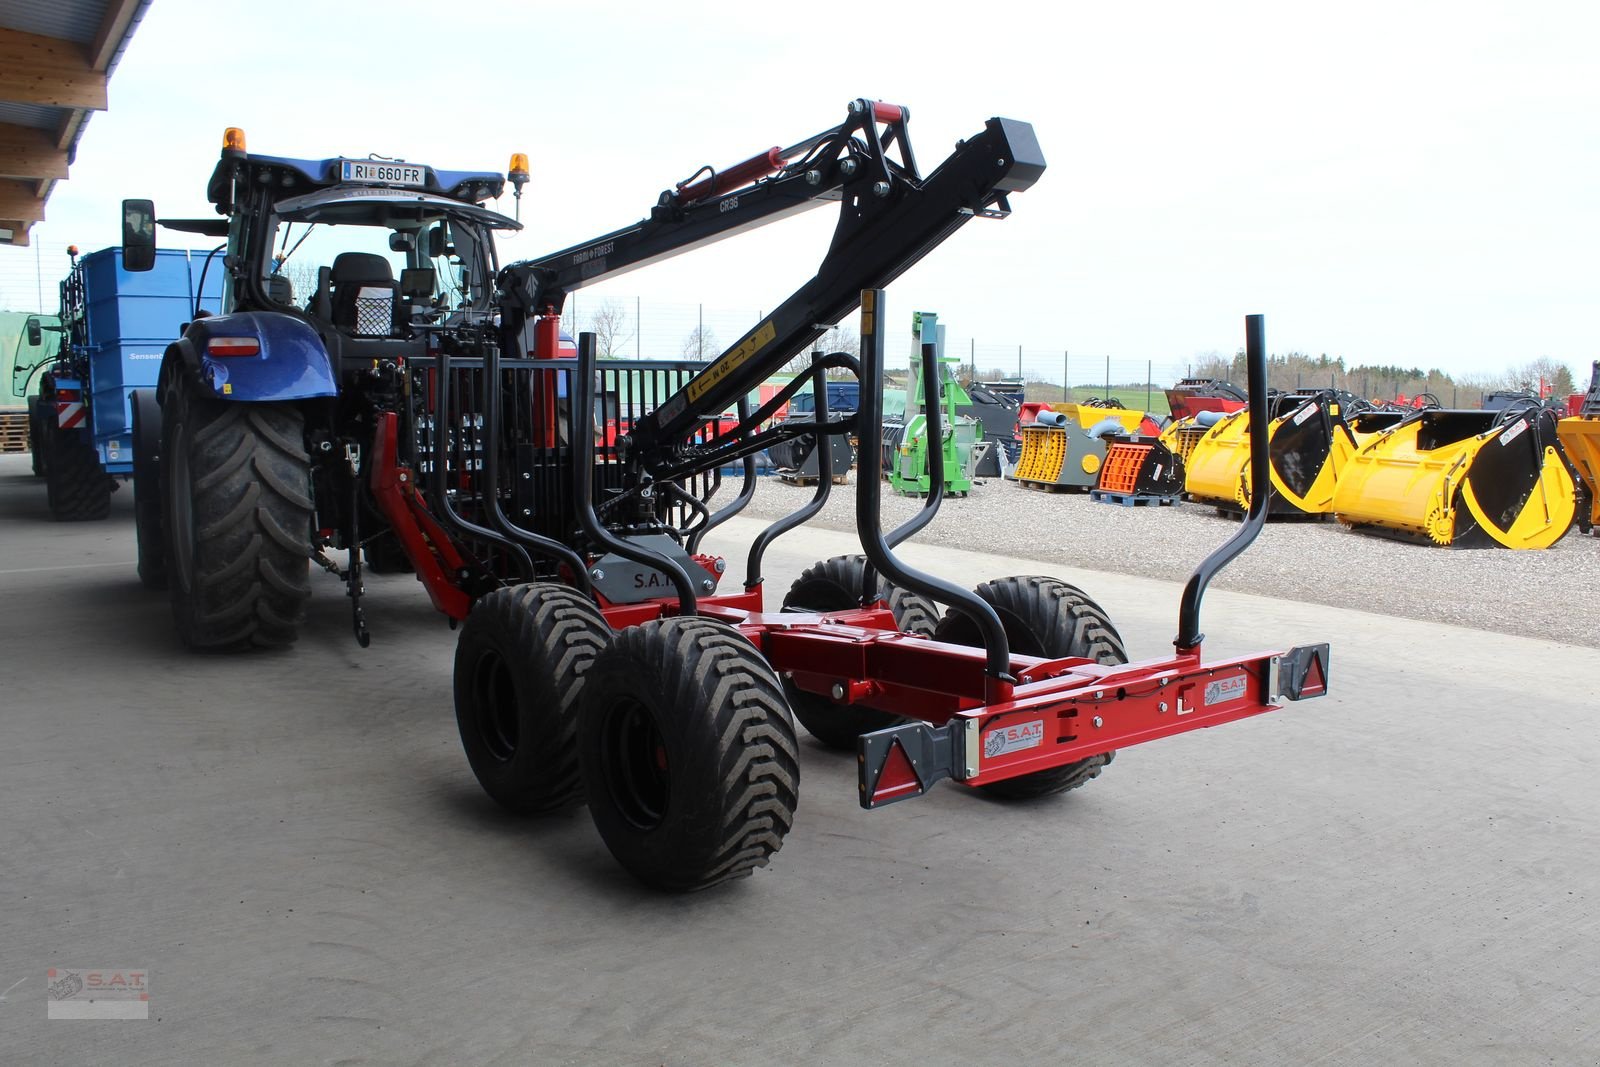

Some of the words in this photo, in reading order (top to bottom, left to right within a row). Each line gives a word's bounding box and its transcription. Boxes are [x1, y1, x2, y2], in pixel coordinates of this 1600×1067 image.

[355, 165, 368, 179] RI
[719, 196, 739, 213] CR36
[593, 241, 614, 259] FOREST
[1007, 723, 1042, 741] S.A.T.
